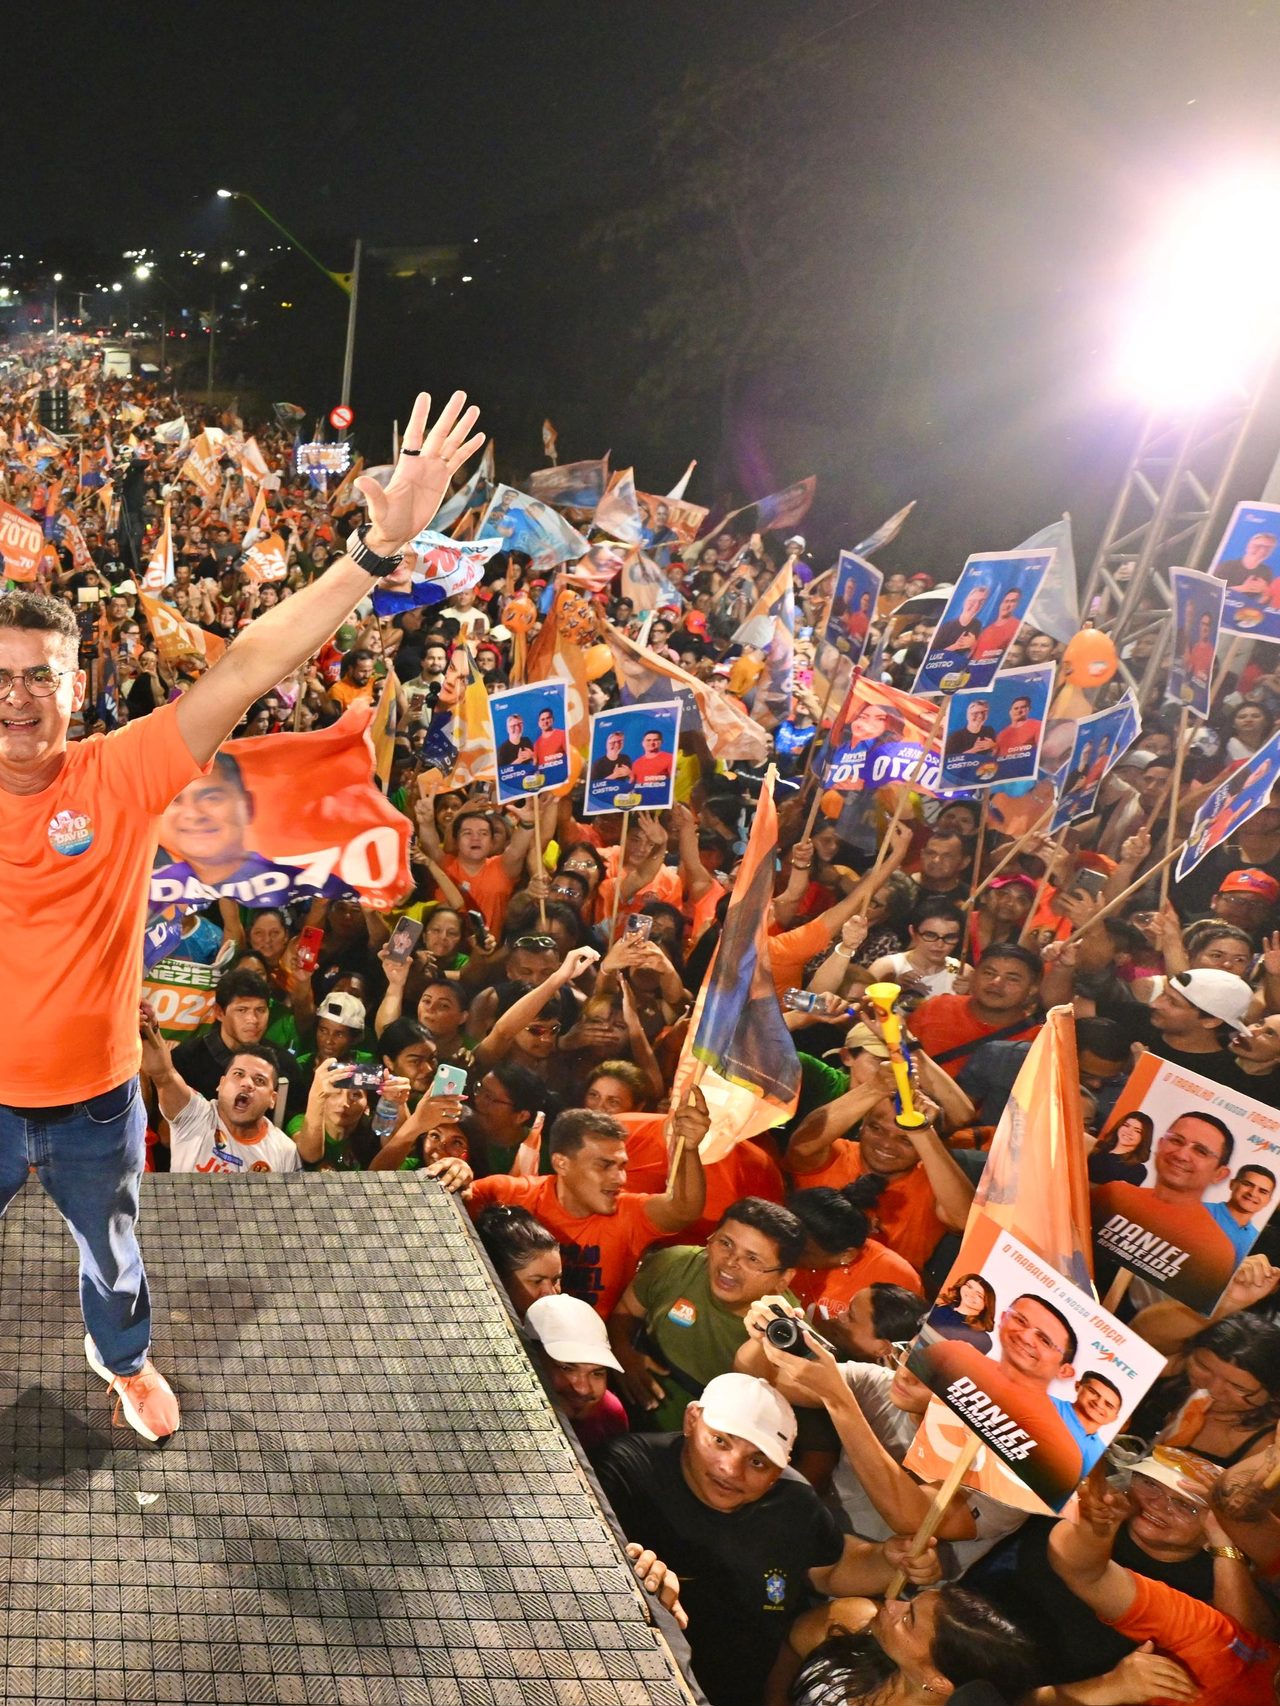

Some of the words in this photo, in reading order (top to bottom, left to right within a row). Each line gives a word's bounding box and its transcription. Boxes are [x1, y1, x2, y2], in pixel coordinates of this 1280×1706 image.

[0, 519, 41, 554] 7070
[925, 661, 954, 669] CASTRO
[929, 653, 945, 661] LUIZ
[1007, 744, 1033, 752] DAVID
[946, 760, 981, 770] CASTRO
[947, 755, 965, 763] LUIZ
[501, 766, 514, 775] LUIZ
[501, 770, 526, 781] CASTRO
[592, 780, 607, 789] LUIZ
[592, 785, 620, 795] CASTRO
[634, 781, 666, 789] ALMEIDA
[56, 829, 89, 844] DAVID
[271, 826, 400, 890] 70
[150, 871, 291, 902] DAVID
[1246, 1111, 1280, 1132] FORÇA
[1247, 1134, 1280, 1155] AVANT
[1097, 1228, 1181, 1278] ALMEIDA
[1104, 1214, 1191, 1271] DANIEL
[1097, 1238, 1133, 1261] DEPUTADO
[1131, 1257, 1169, 1282] ESTADUAL
[1002, 1244, 1011, 1254] O
[1011, 1250, 1056, 1289] TRABALHO
[1065, 1297, 1091, 1318] NOSSA
[1089, 1315, 1127, 1346] FORÇA!
[1091, 1340, 1138, 1380] AVANTE
[946, 1385, 1030, 1461] ALMEIDA
[952, 1376, 1039, 1455] DANIEL
[946, 1395, 983, 1428] DEPUTADO
[981, 1426, 1018, 1462] ESTADUAL
